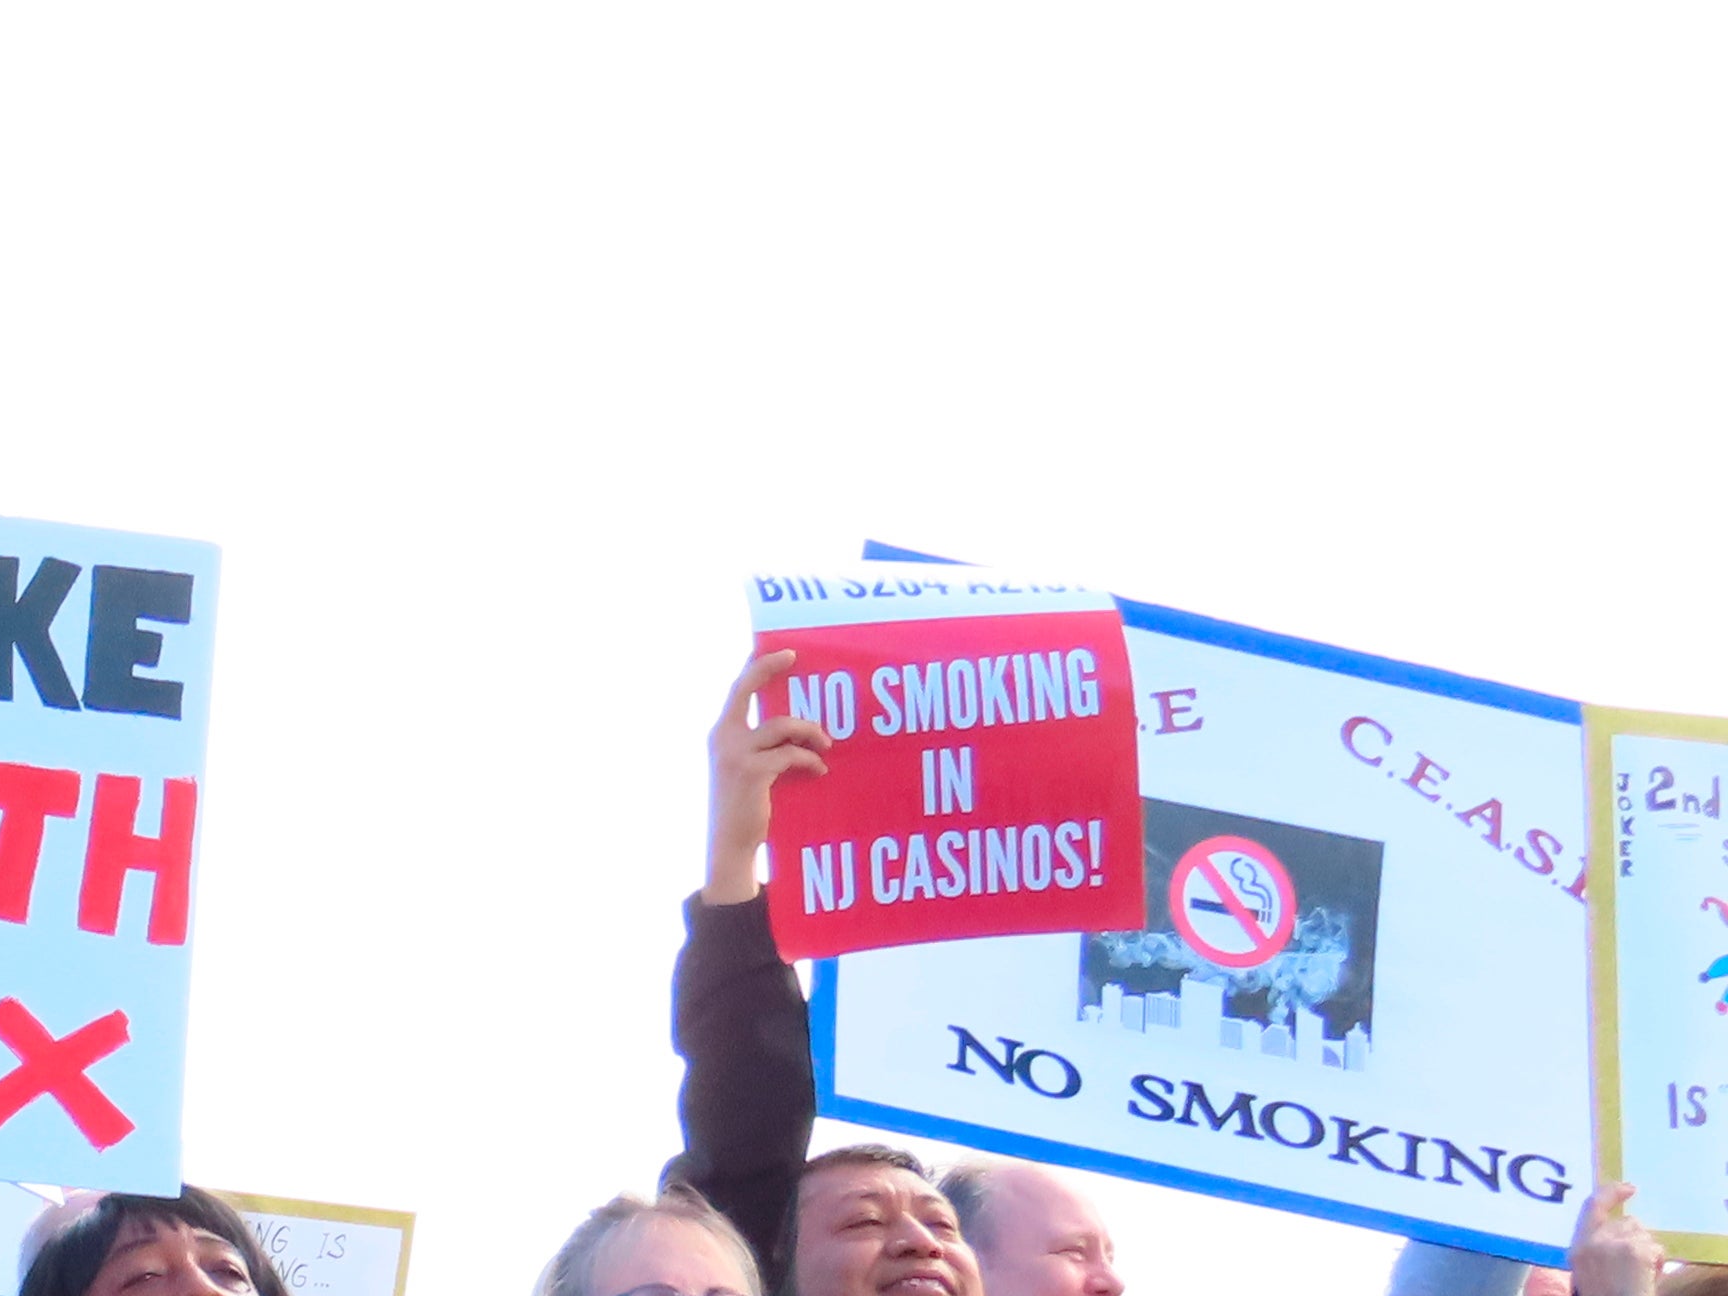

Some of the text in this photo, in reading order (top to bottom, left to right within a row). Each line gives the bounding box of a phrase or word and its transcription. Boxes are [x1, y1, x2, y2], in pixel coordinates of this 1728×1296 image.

[787, 648, 1100, 741] NO SMOKING
[921, 746, 973, 816] IN
[1645, 764, 1721, 818] 2nd
[800, 820, 1103, 915] NJ CASINOS!
[946, 1023, 1573, 1204] NO SMOKING
